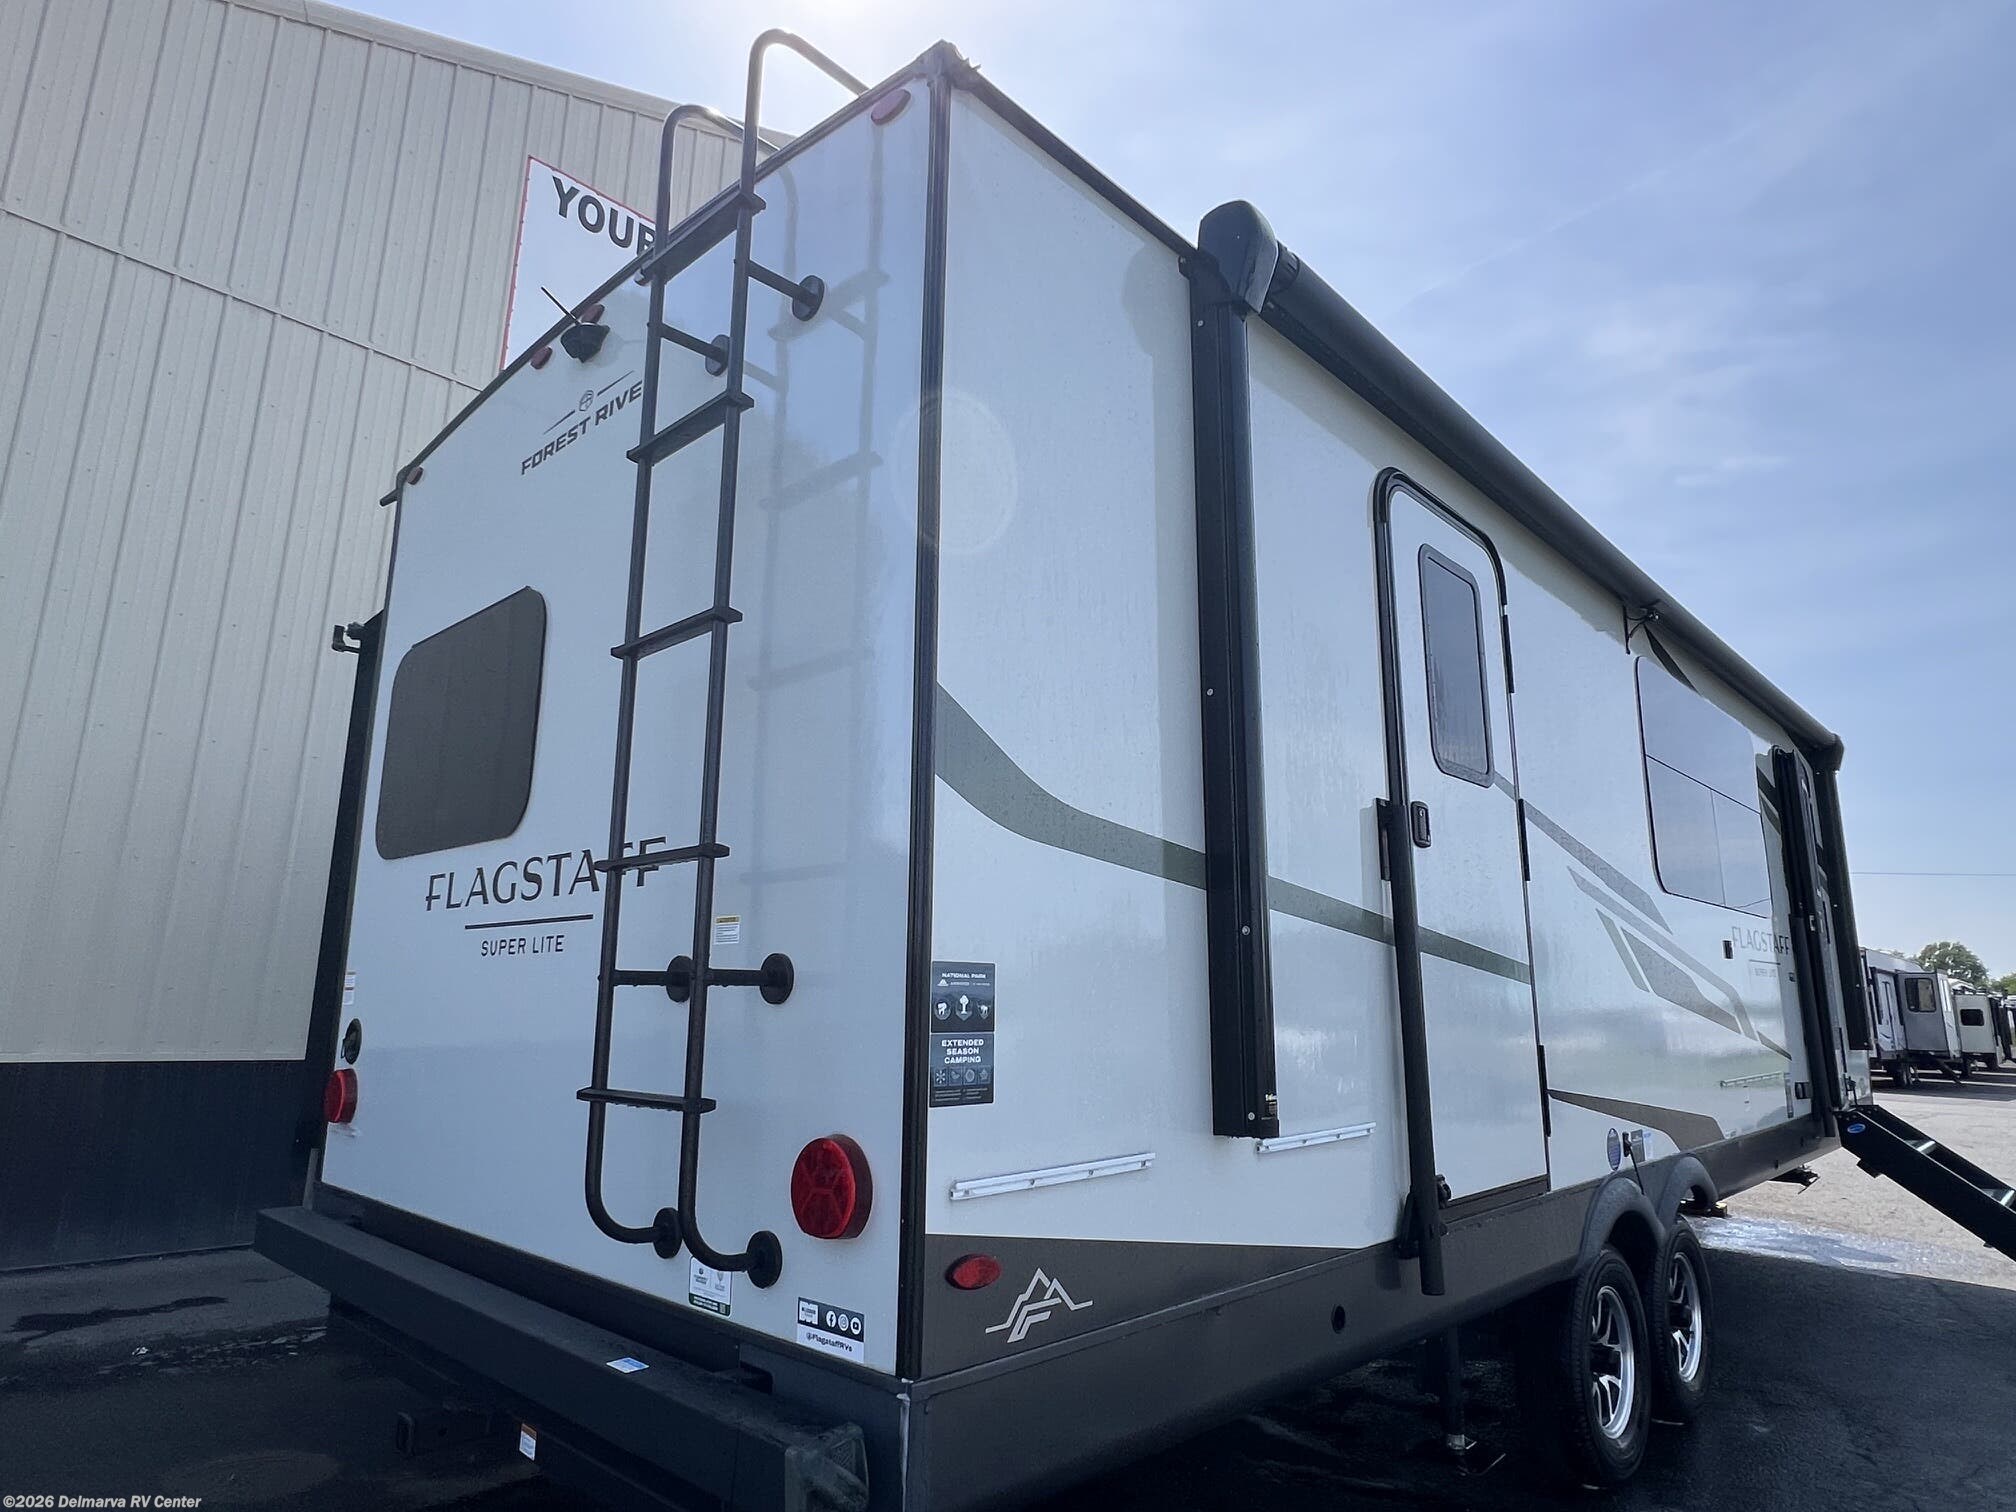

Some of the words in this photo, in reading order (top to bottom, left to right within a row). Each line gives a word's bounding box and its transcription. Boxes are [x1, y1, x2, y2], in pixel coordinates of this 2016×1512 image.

[521, 416, 591, 475] FOREST
[595, 380, 643, 426] RIVE
[480, 938, 527, 957] SUPER
[532, 934, 565, 953] LITE
[941, 1039, 984, 1047] EXTENDED
[944, 1056, 981, 1064] CAMPING
[806, 1332, 853, 1352] @FlagstaffRVs
